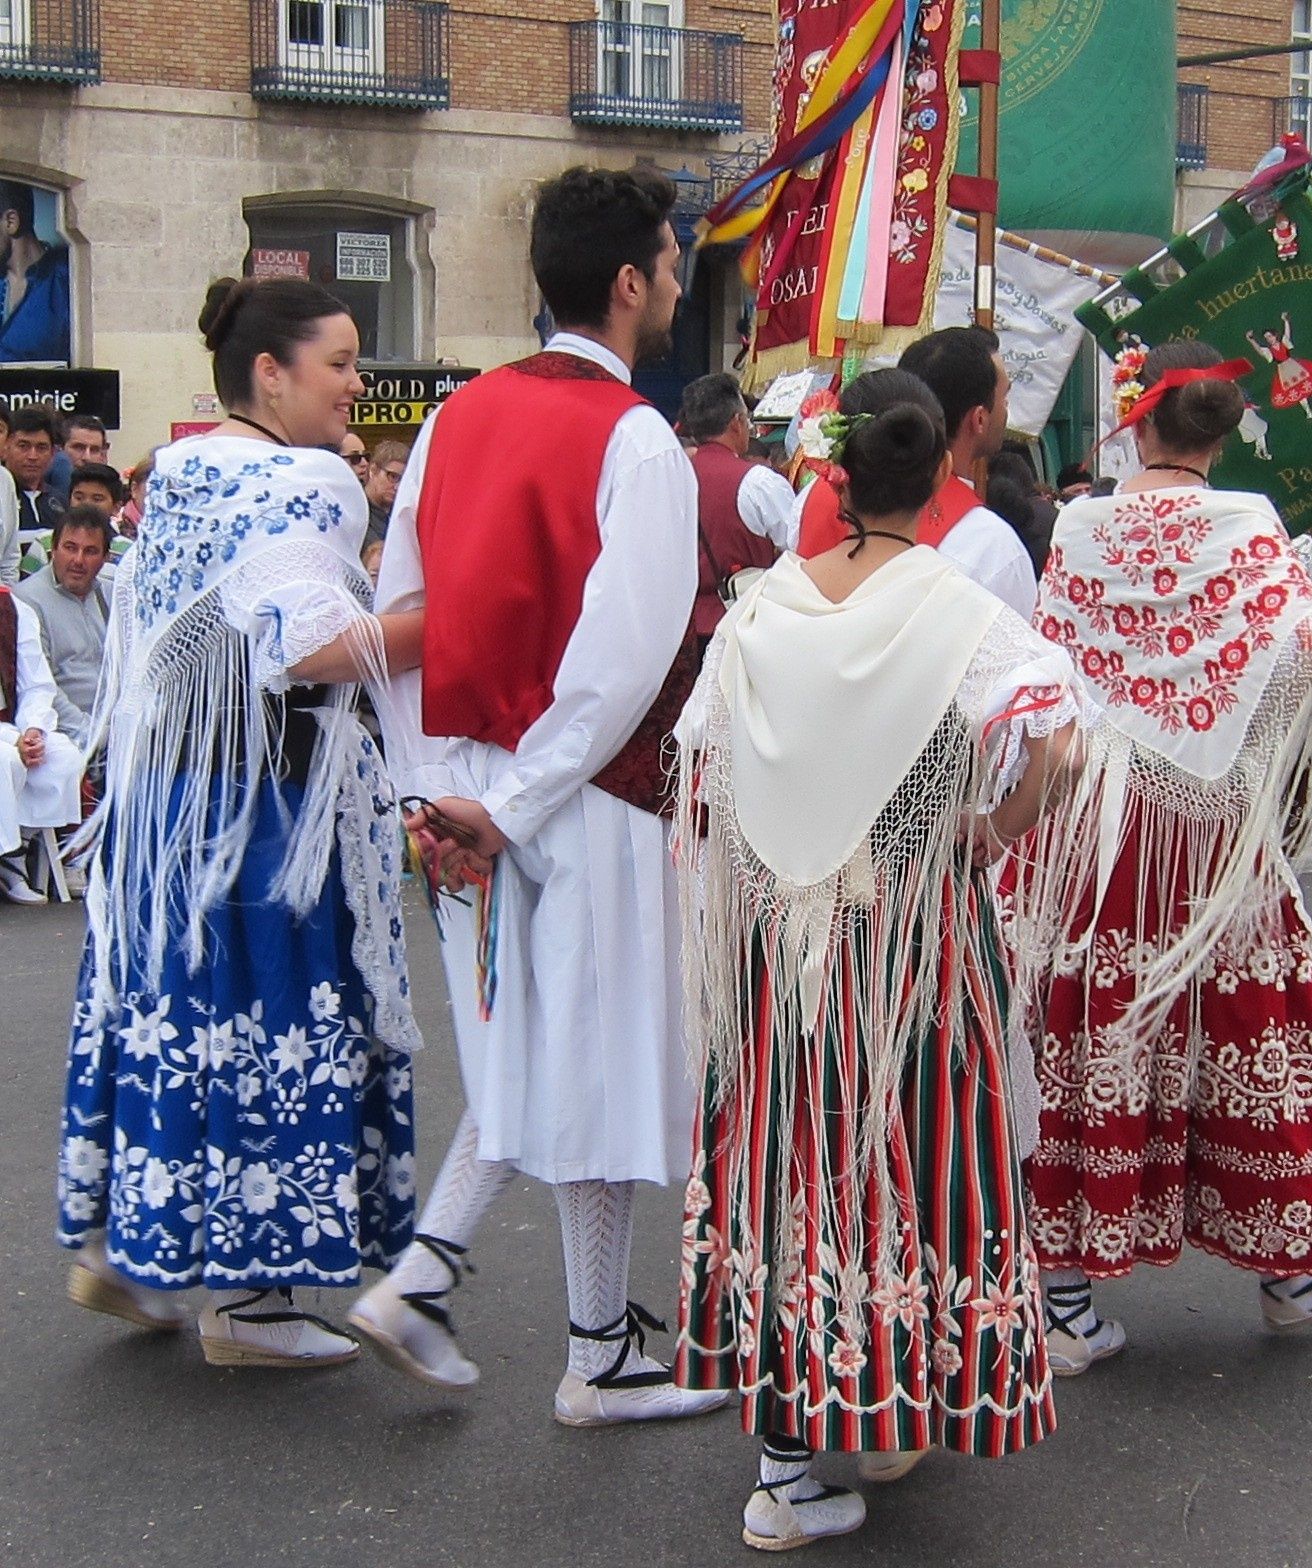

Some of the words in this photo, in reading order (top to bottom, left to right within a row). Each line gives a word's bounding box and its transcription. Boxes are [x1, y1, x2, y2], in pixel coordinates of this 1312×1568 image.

[340, 239, 388, 248] VICTORIA
[258, 251, 302, 264] LOCAL
[254, 265, 305, 276] DISPONIBLE
[956, 265, 971, 281] de
[1001, 348, 1048, 370] ntigua
[357, 371, 425, 400] GOLD
[0, 389, 76, 412] micie
[351, 403, 412, 423] PRO
